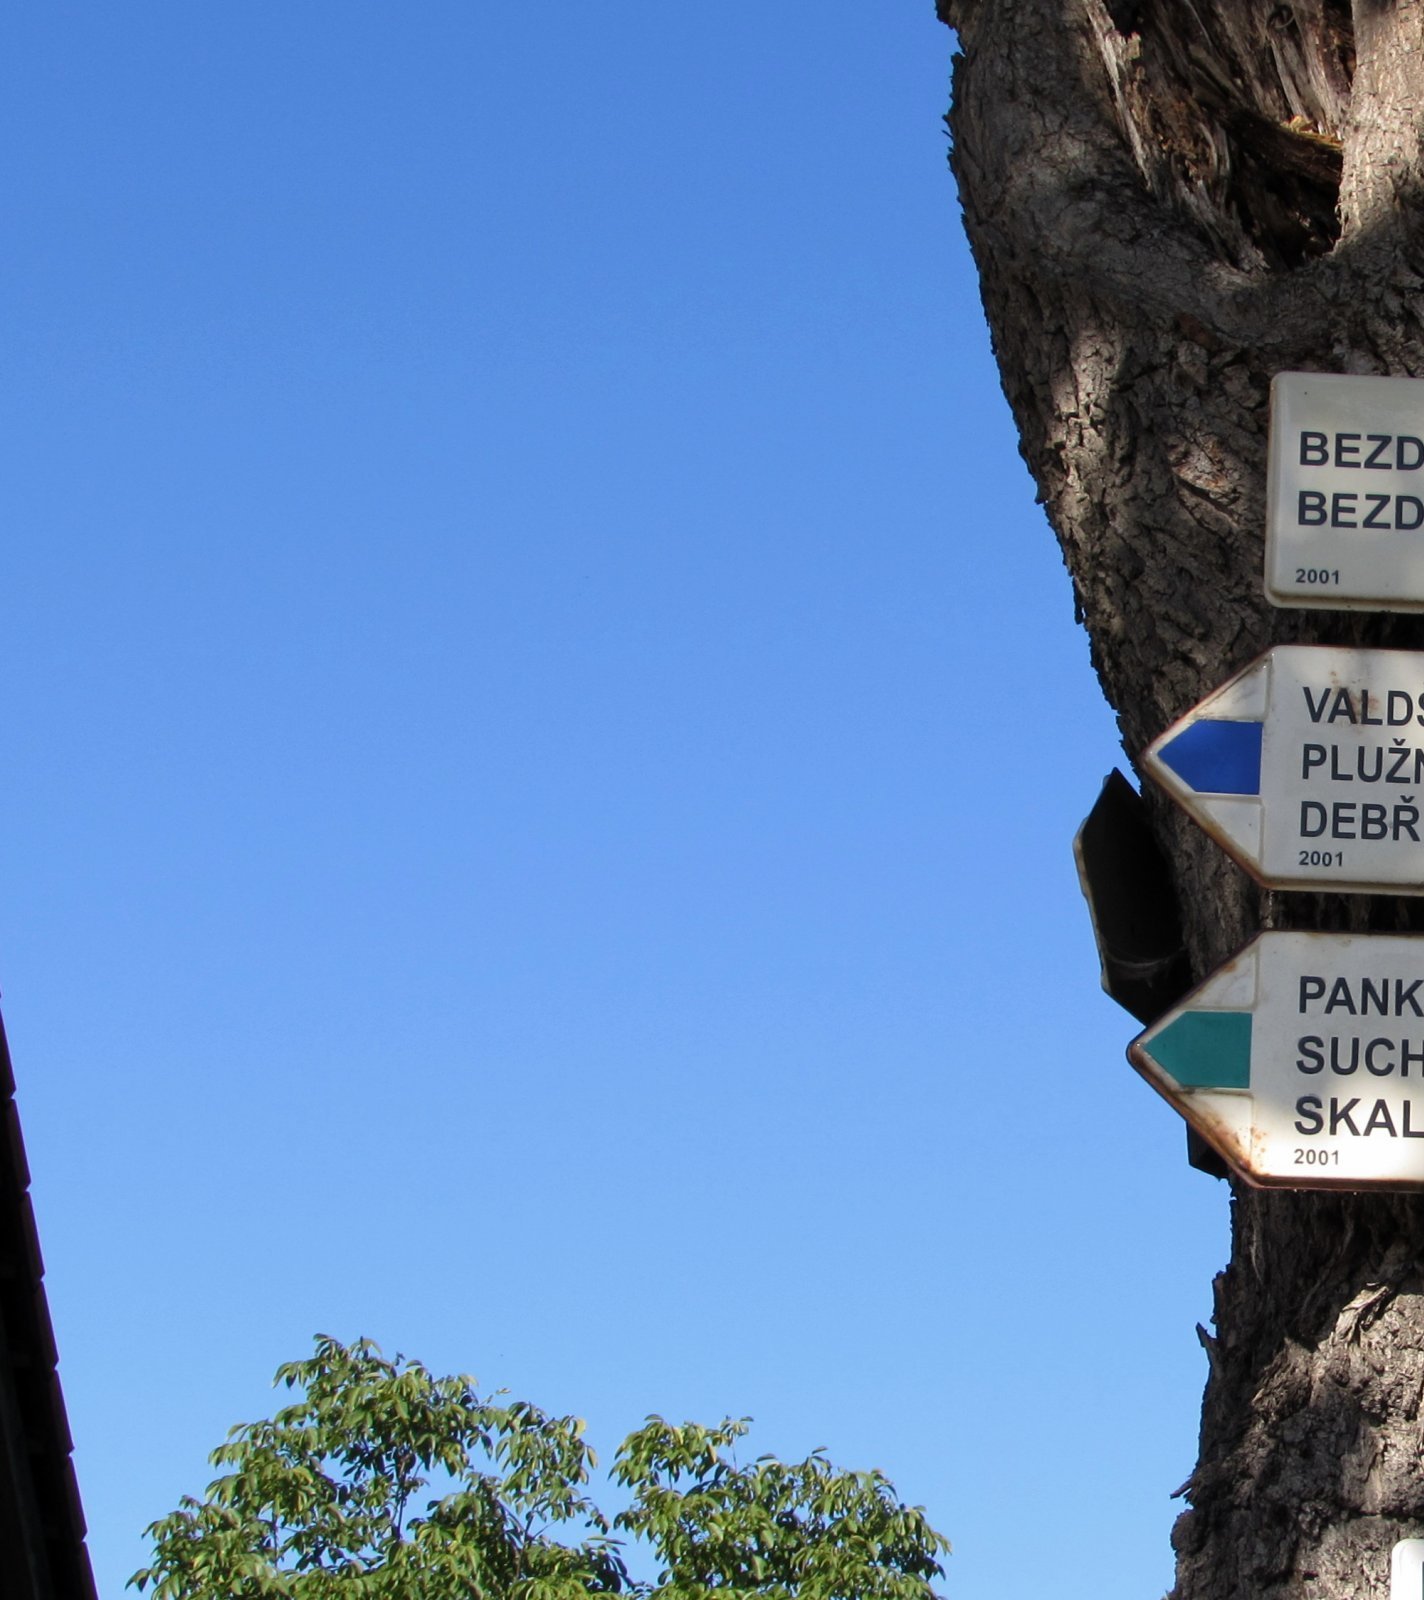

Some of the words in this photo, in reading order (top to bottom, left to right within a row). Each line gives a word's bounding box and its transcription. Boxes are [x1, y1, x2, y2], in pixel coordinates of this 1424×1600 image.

[1295, 568, 1339, 585] 2001
[1300, 794, 1421, 842] DEBŘ
[1298, 850, 1343, 868] 2001
[1294, 1148, 1339, 1166] 2001
